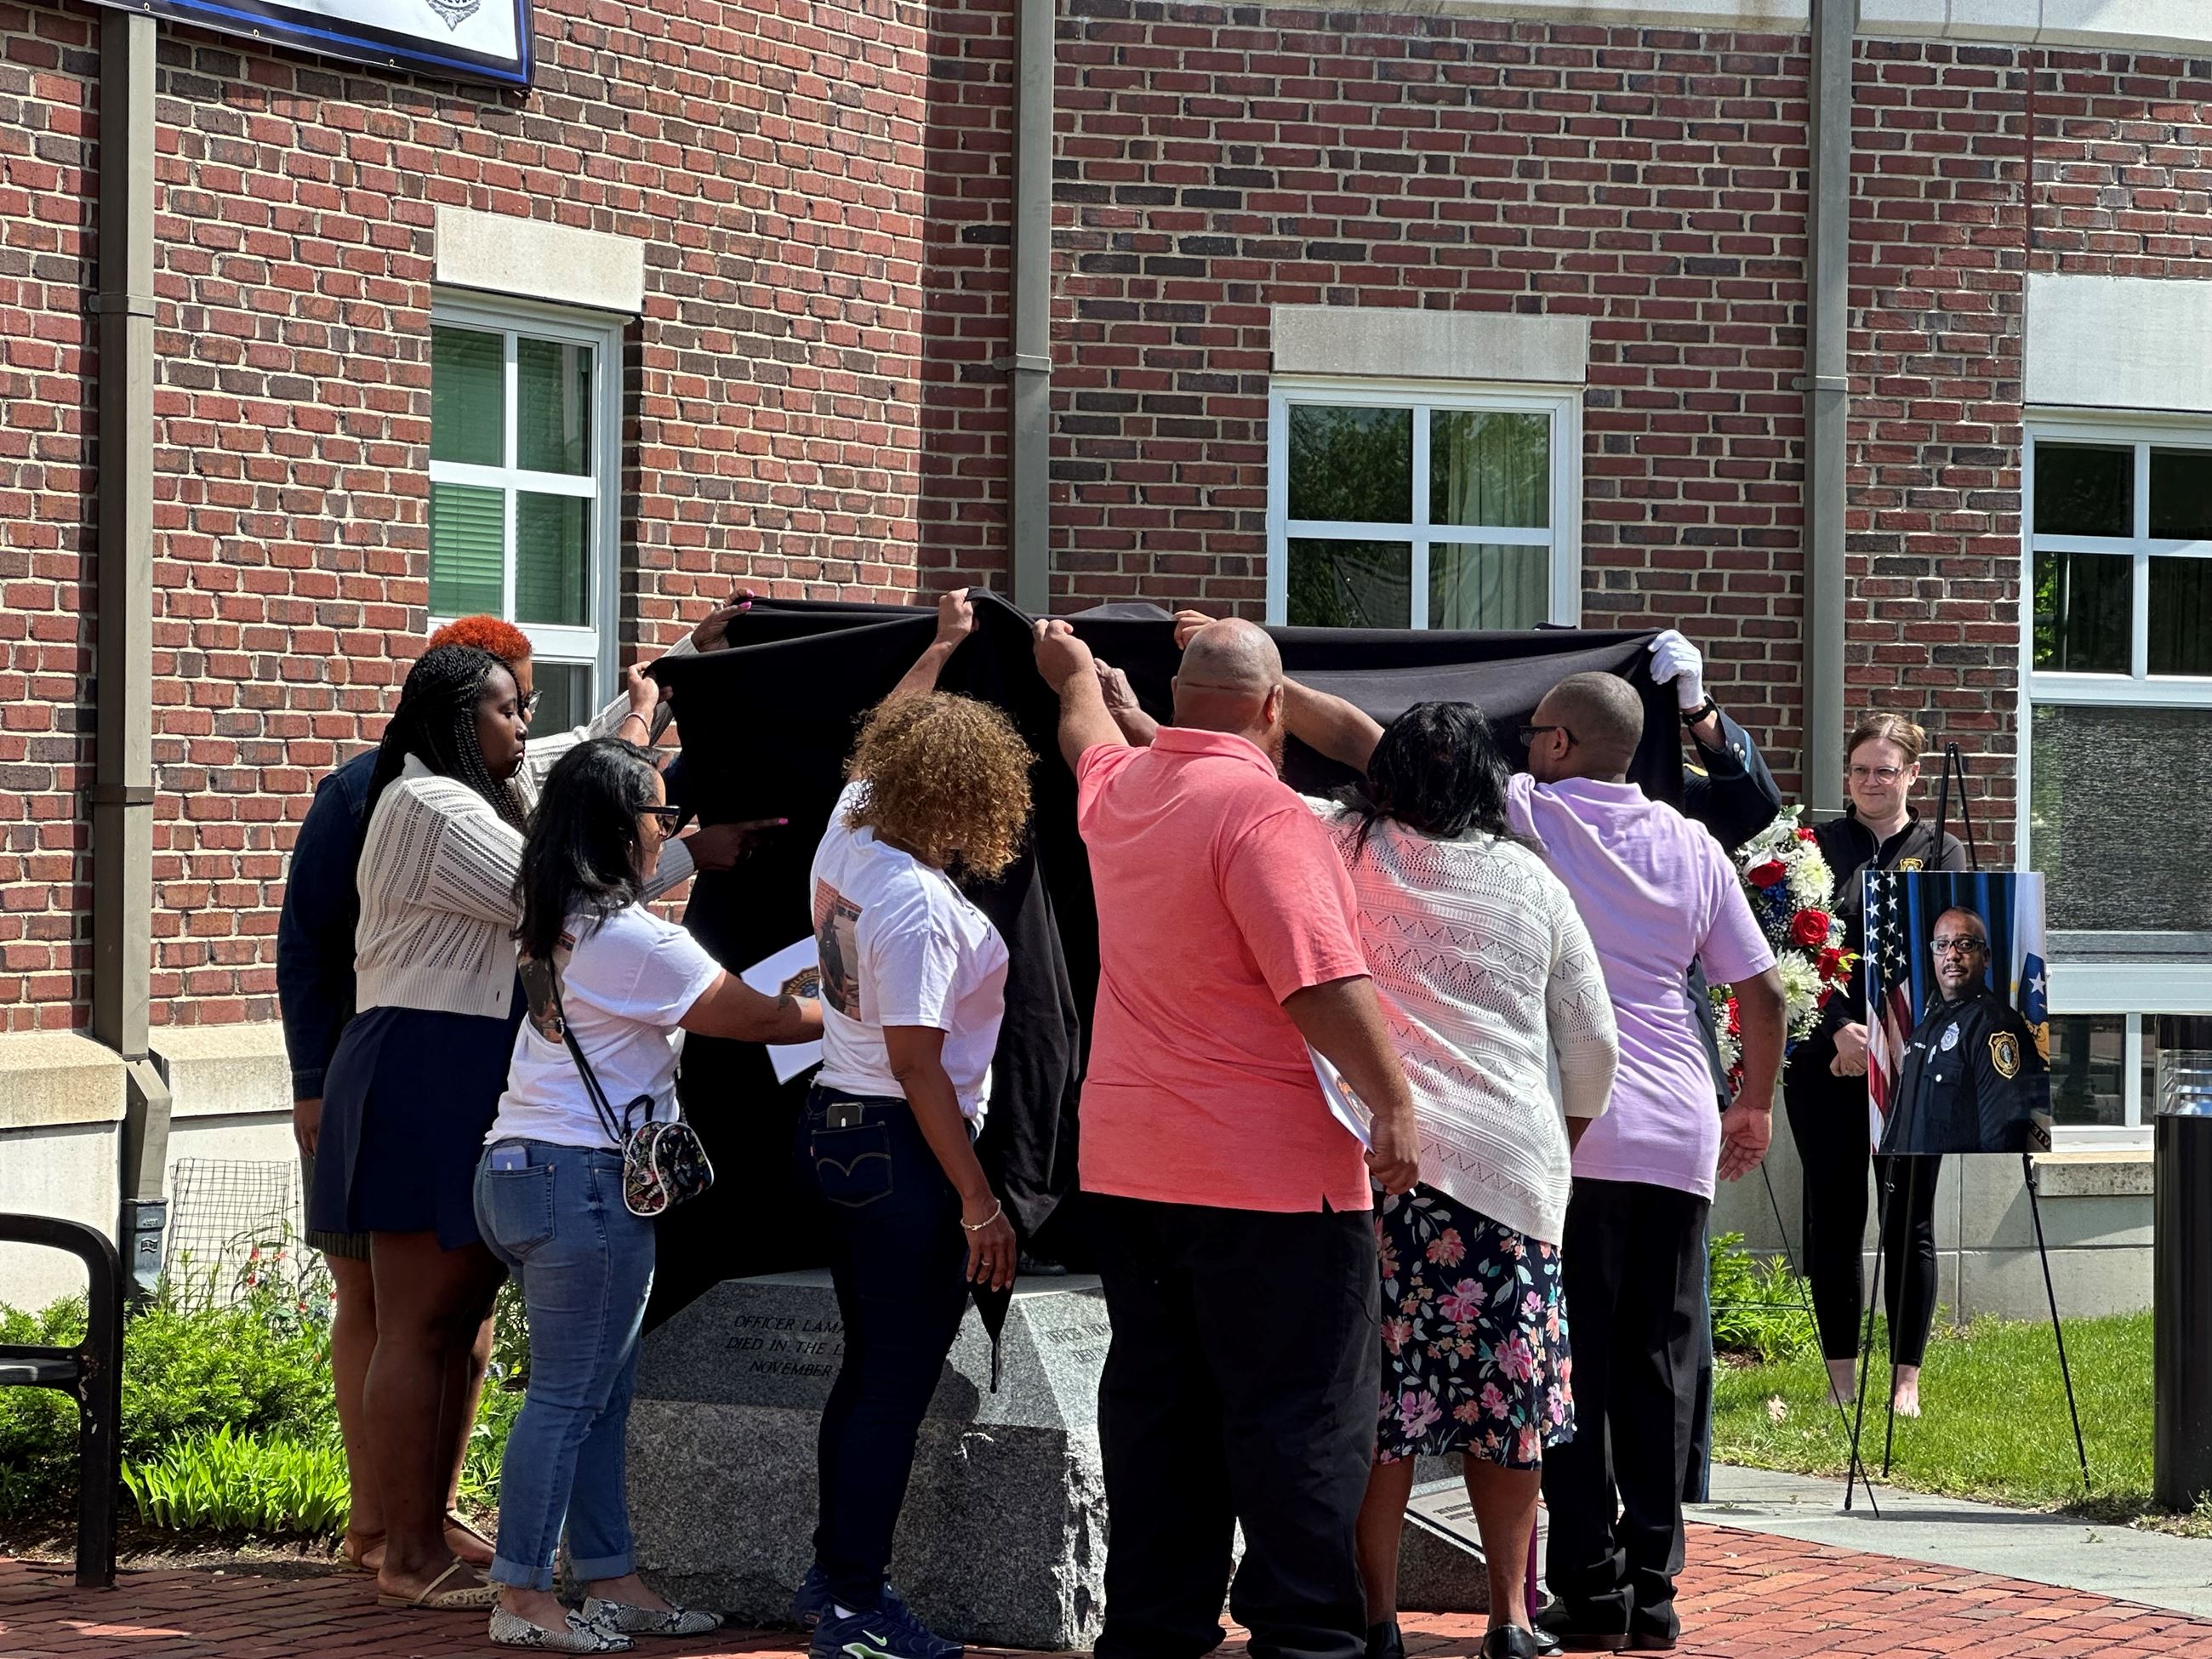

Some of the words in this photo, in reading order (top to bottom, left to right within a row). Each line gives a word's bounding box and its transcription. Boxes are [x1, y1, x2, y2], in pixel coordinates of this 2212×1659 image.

[734, 1315, 795, 1331] OFFICER
[725, 1337, 764, 1350] DIED
[769, 1339, 788, 1352] IN
[796, 1341, 828, 1355] THE
[749, 1361, 833, 1377] NOVEMBER
